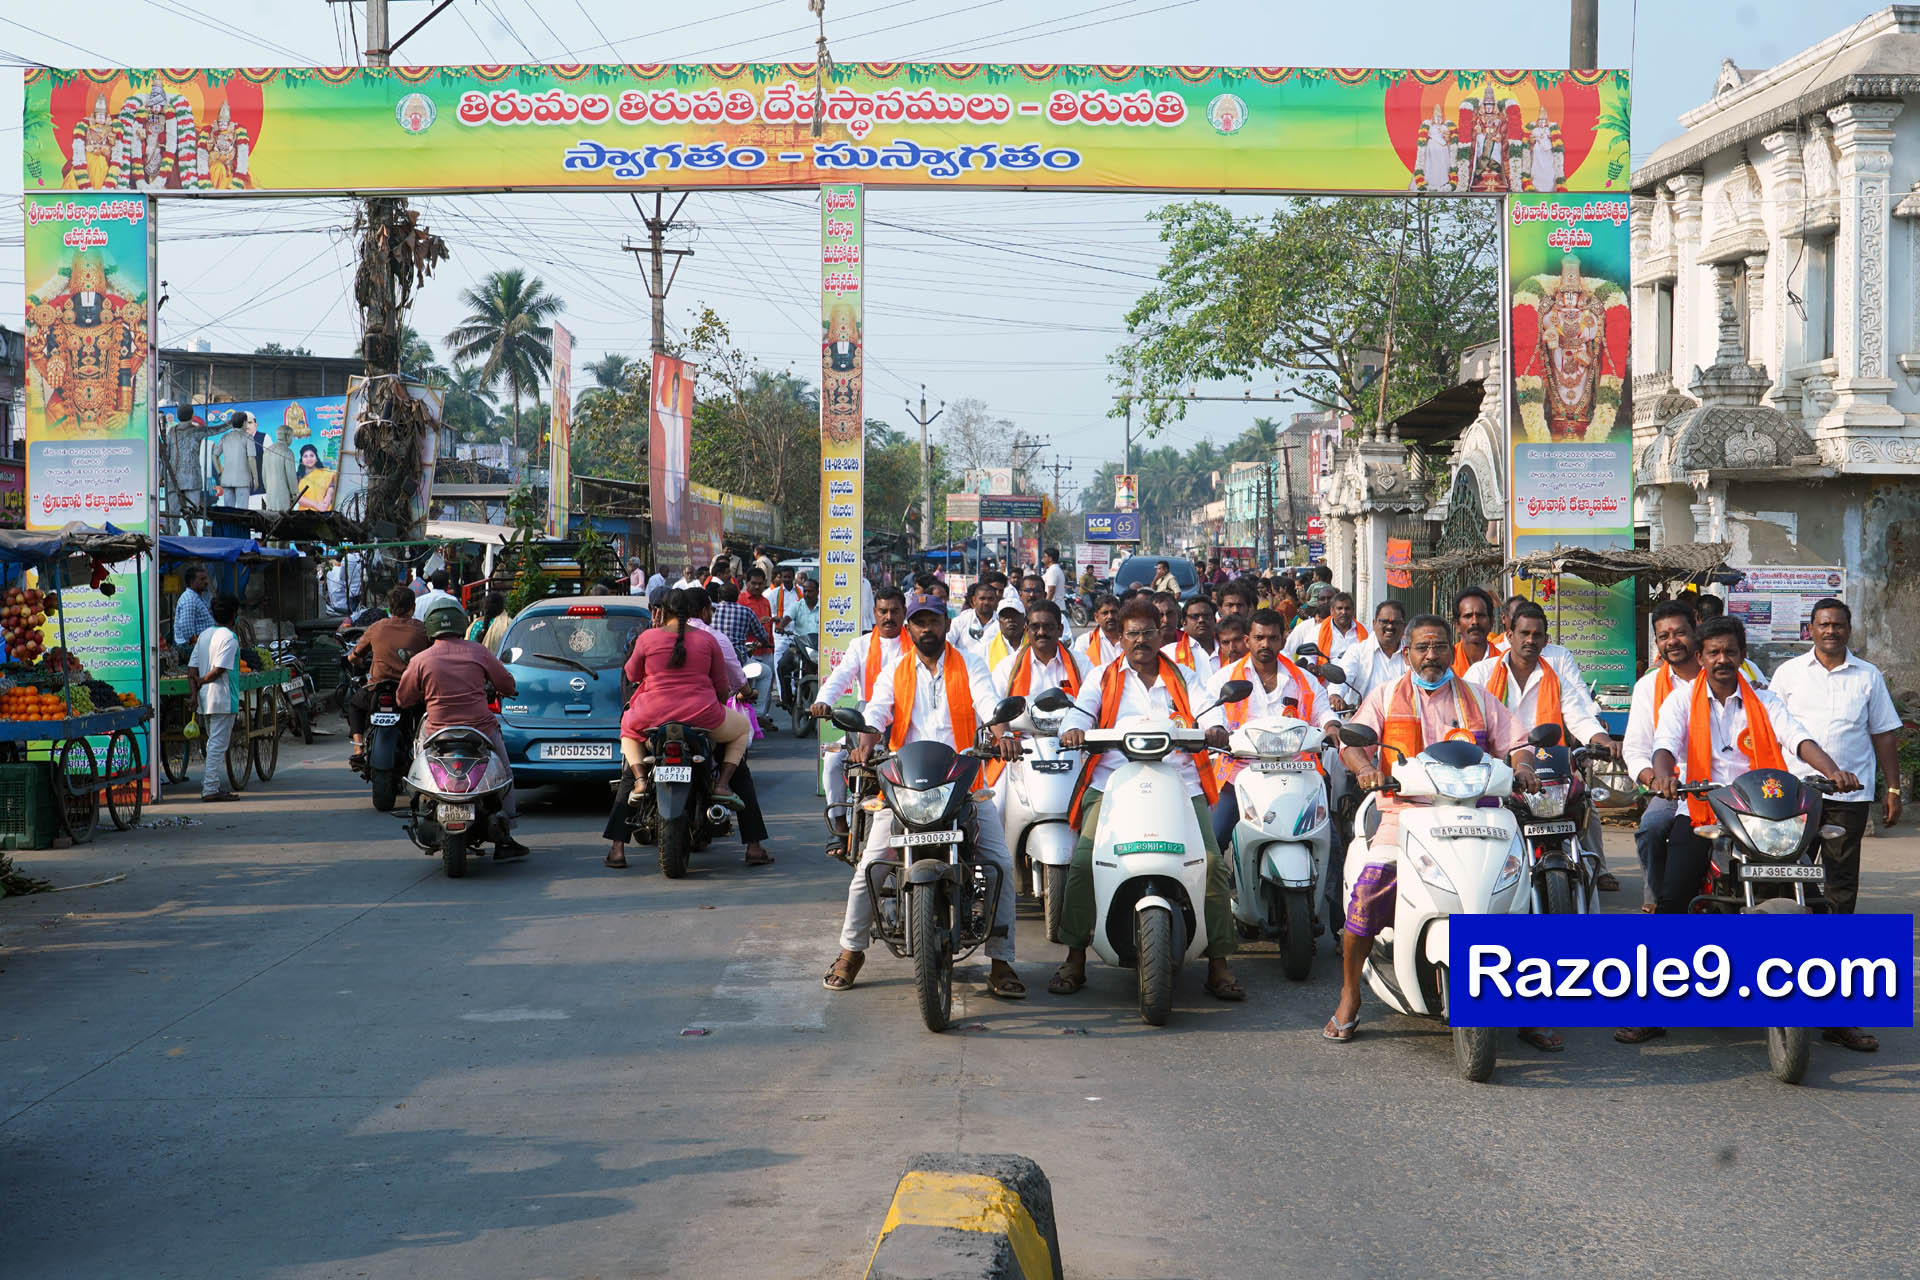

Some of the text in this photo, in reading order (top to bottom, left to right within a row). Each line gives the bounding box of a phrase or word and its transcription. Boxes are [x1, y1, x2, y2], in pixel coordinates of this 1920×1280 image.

[459, 90, 610, 124] తిరుమల
[619, 90, 755, 124] తిరుపతి
[764, 84, 1010, 137] దేవస్థానములు
[1050, 92, 1186, 125] తిరుపతి
[564, 142, 766, 178] స్వాగతం
[815, 141, 1079, 177] సుస్వాగతం
[28, 202, 64, 225] శ్రీనివాస
[1512, 202, 1548, 226] శ్రీనివాస
[824, 458, 860, 470] 14-02-2026
[1088, 519, 1111, 527] KCP
[1050, 762, 1070, 770] 32
